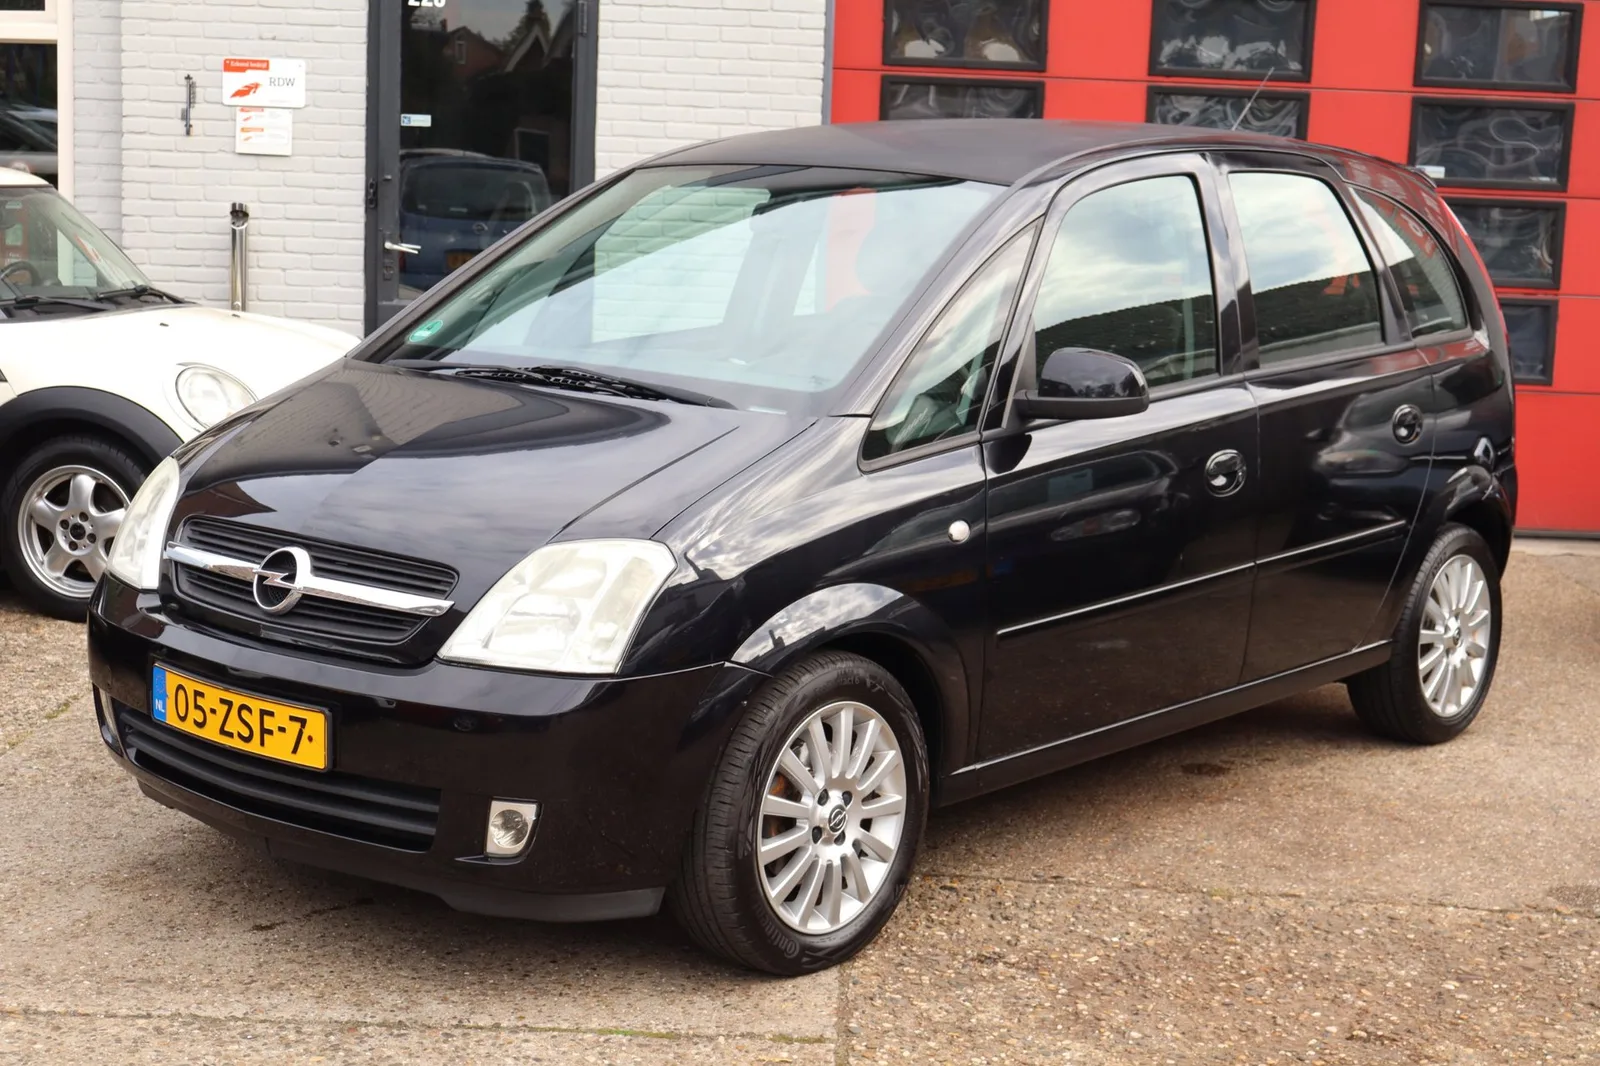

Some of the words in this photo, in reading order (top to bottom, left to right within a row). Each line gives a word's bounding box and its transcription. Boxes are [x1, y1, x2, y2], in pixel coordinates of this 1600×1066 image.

[269, 77, 296, 87] RDW
[155, 698, 165, 713] NL
[174, 684, 308, 755] 05-ZSF-7
